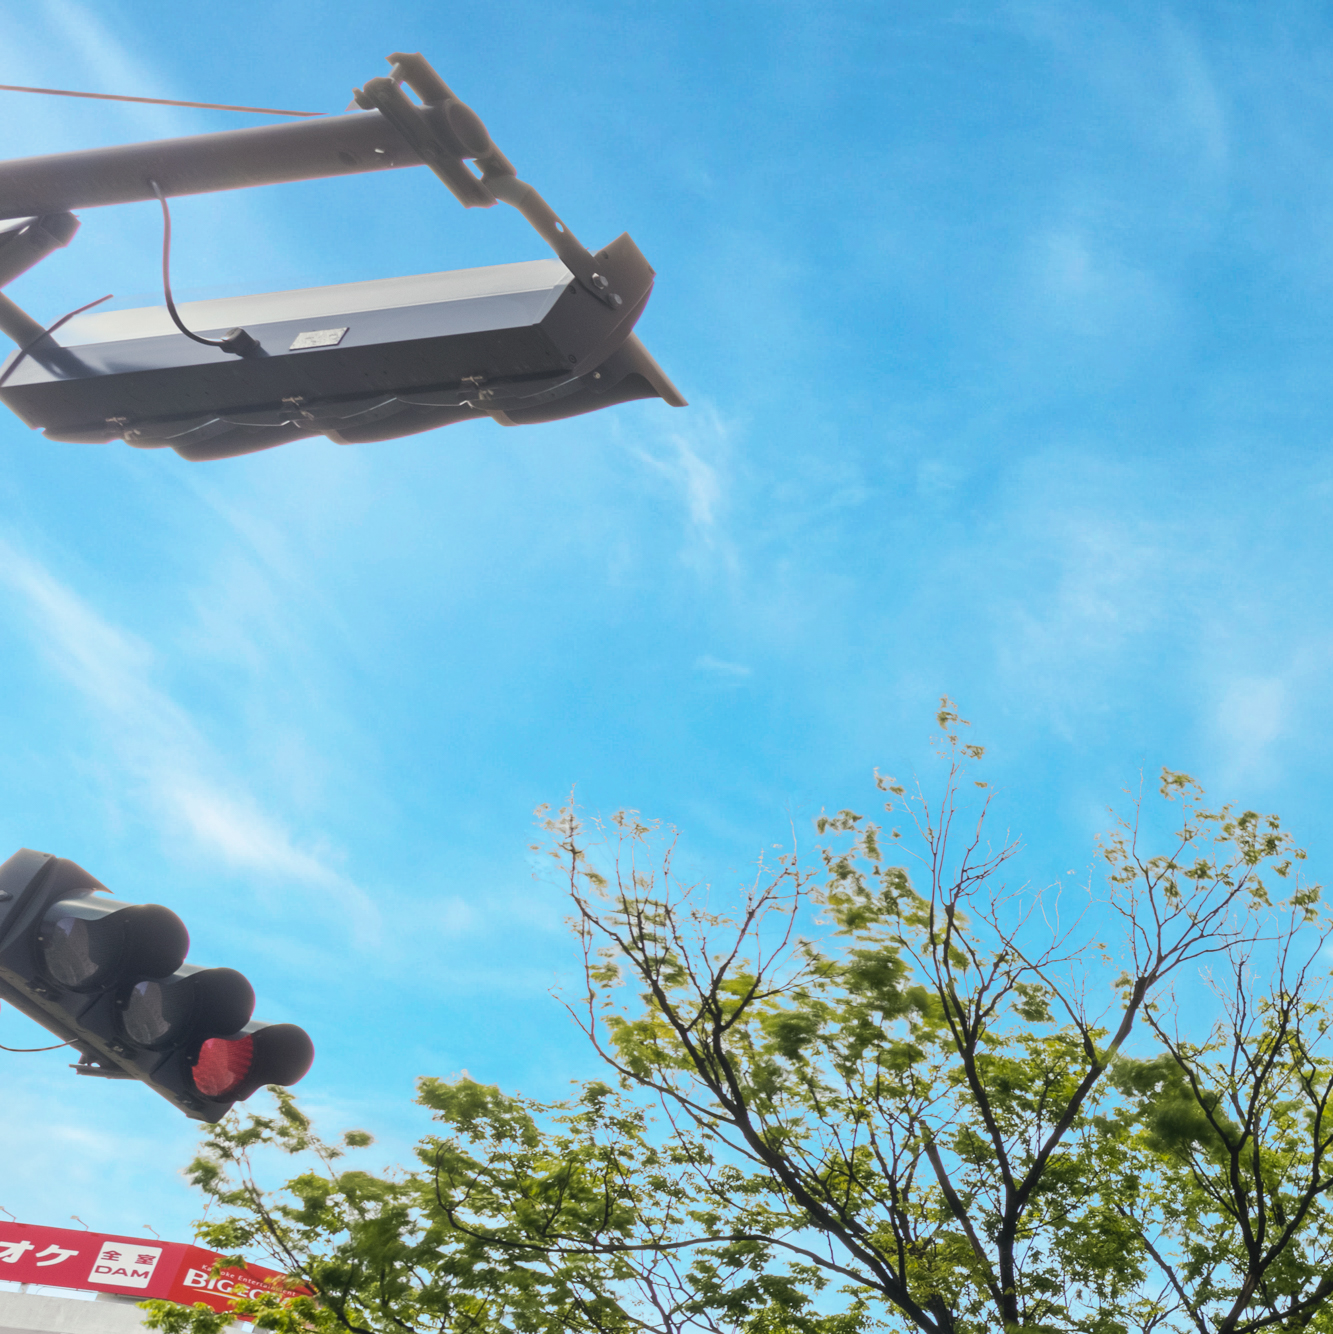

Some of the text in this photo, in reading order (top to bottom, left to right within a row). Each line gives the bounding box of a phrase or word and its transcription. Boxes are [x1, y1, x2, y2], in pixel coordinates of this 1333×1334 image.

[94, 1265, 150, 1280] DAM
[202, 1264, 235, 1279] Kaoke
[183, 1268, 234, 1294] BIG
